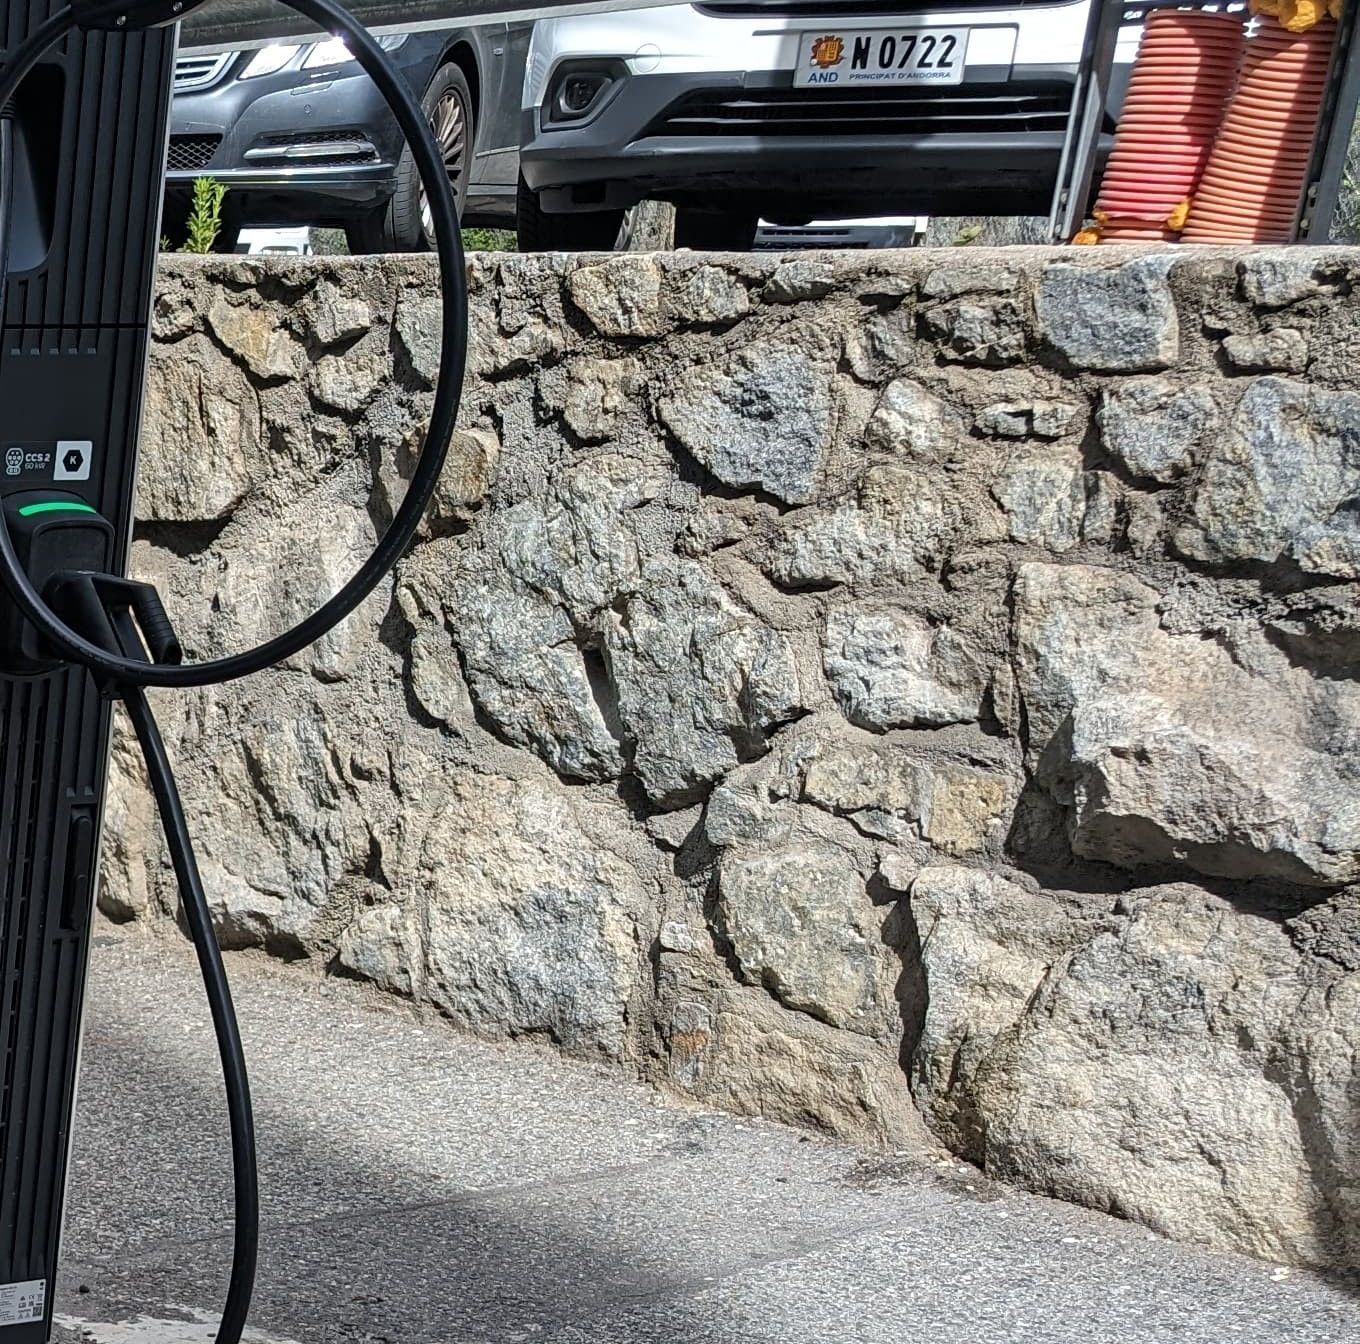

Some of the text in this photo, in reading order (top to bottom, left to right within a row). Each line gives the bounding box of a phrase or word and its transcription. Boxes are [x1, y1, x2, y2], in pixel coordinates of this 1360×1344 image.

[851, 34, 957, 70] N 0722
[808, 72, 839, 83] AND
[849, 71, 952, 81] PRINCIPAT D'ANDORRA
[25, 453, 51, 462] CCS 2
[69, 456, 77, 465] K
